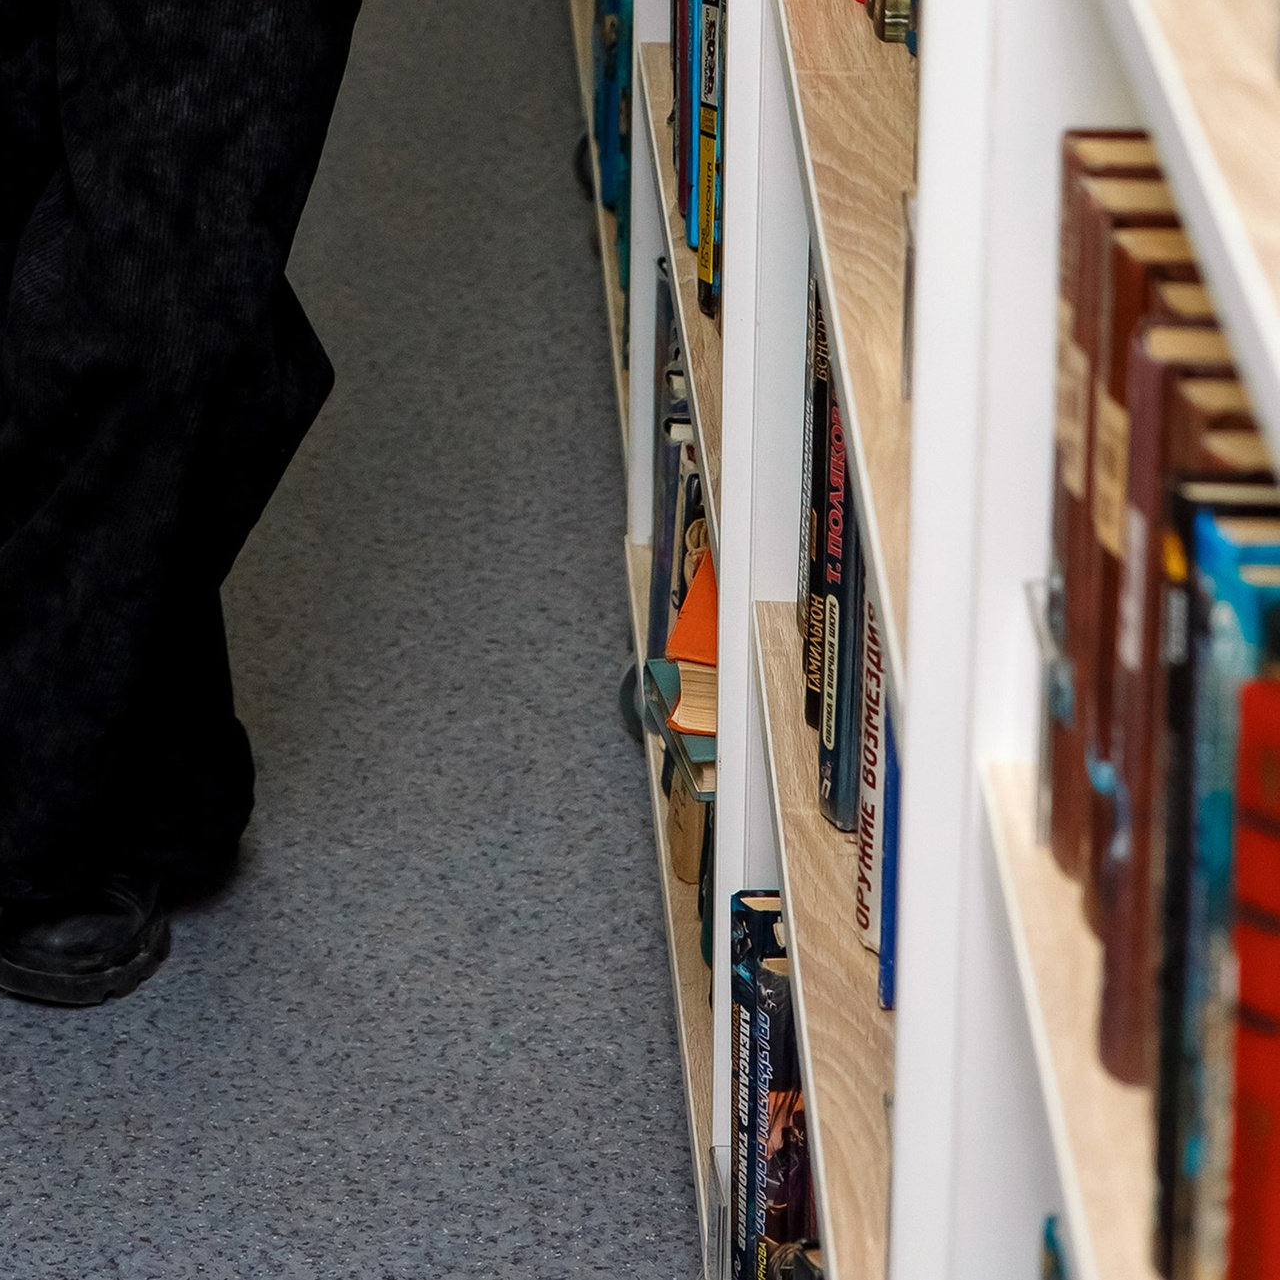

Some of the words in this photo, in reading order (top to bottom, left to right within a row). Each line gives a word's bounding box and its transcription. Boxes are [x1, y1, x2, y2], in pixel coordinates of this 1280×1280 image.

[829, 395, 846, 560] ПОЛЯКОВ
[827, 599, 837, 640] ШКУРЕ
[829, 567, 842, 584] Т.
[807, 593, 824, 694] ГАМИЛЬТОН
[826, 641, 836, 690] ВОЛЧЬЕЙ
[860, 601, 884, 791] ВОЗМЕЗДИЯ
[825, 703, 834, 744] ОВЕЧКА
[855, 795, 876, 931] ОРУЖИЕ
[738, 1005, 751, 1127] АЛЕКСАНДР
[737, 1131, 749, 1252] ТАМОНИКОВ
